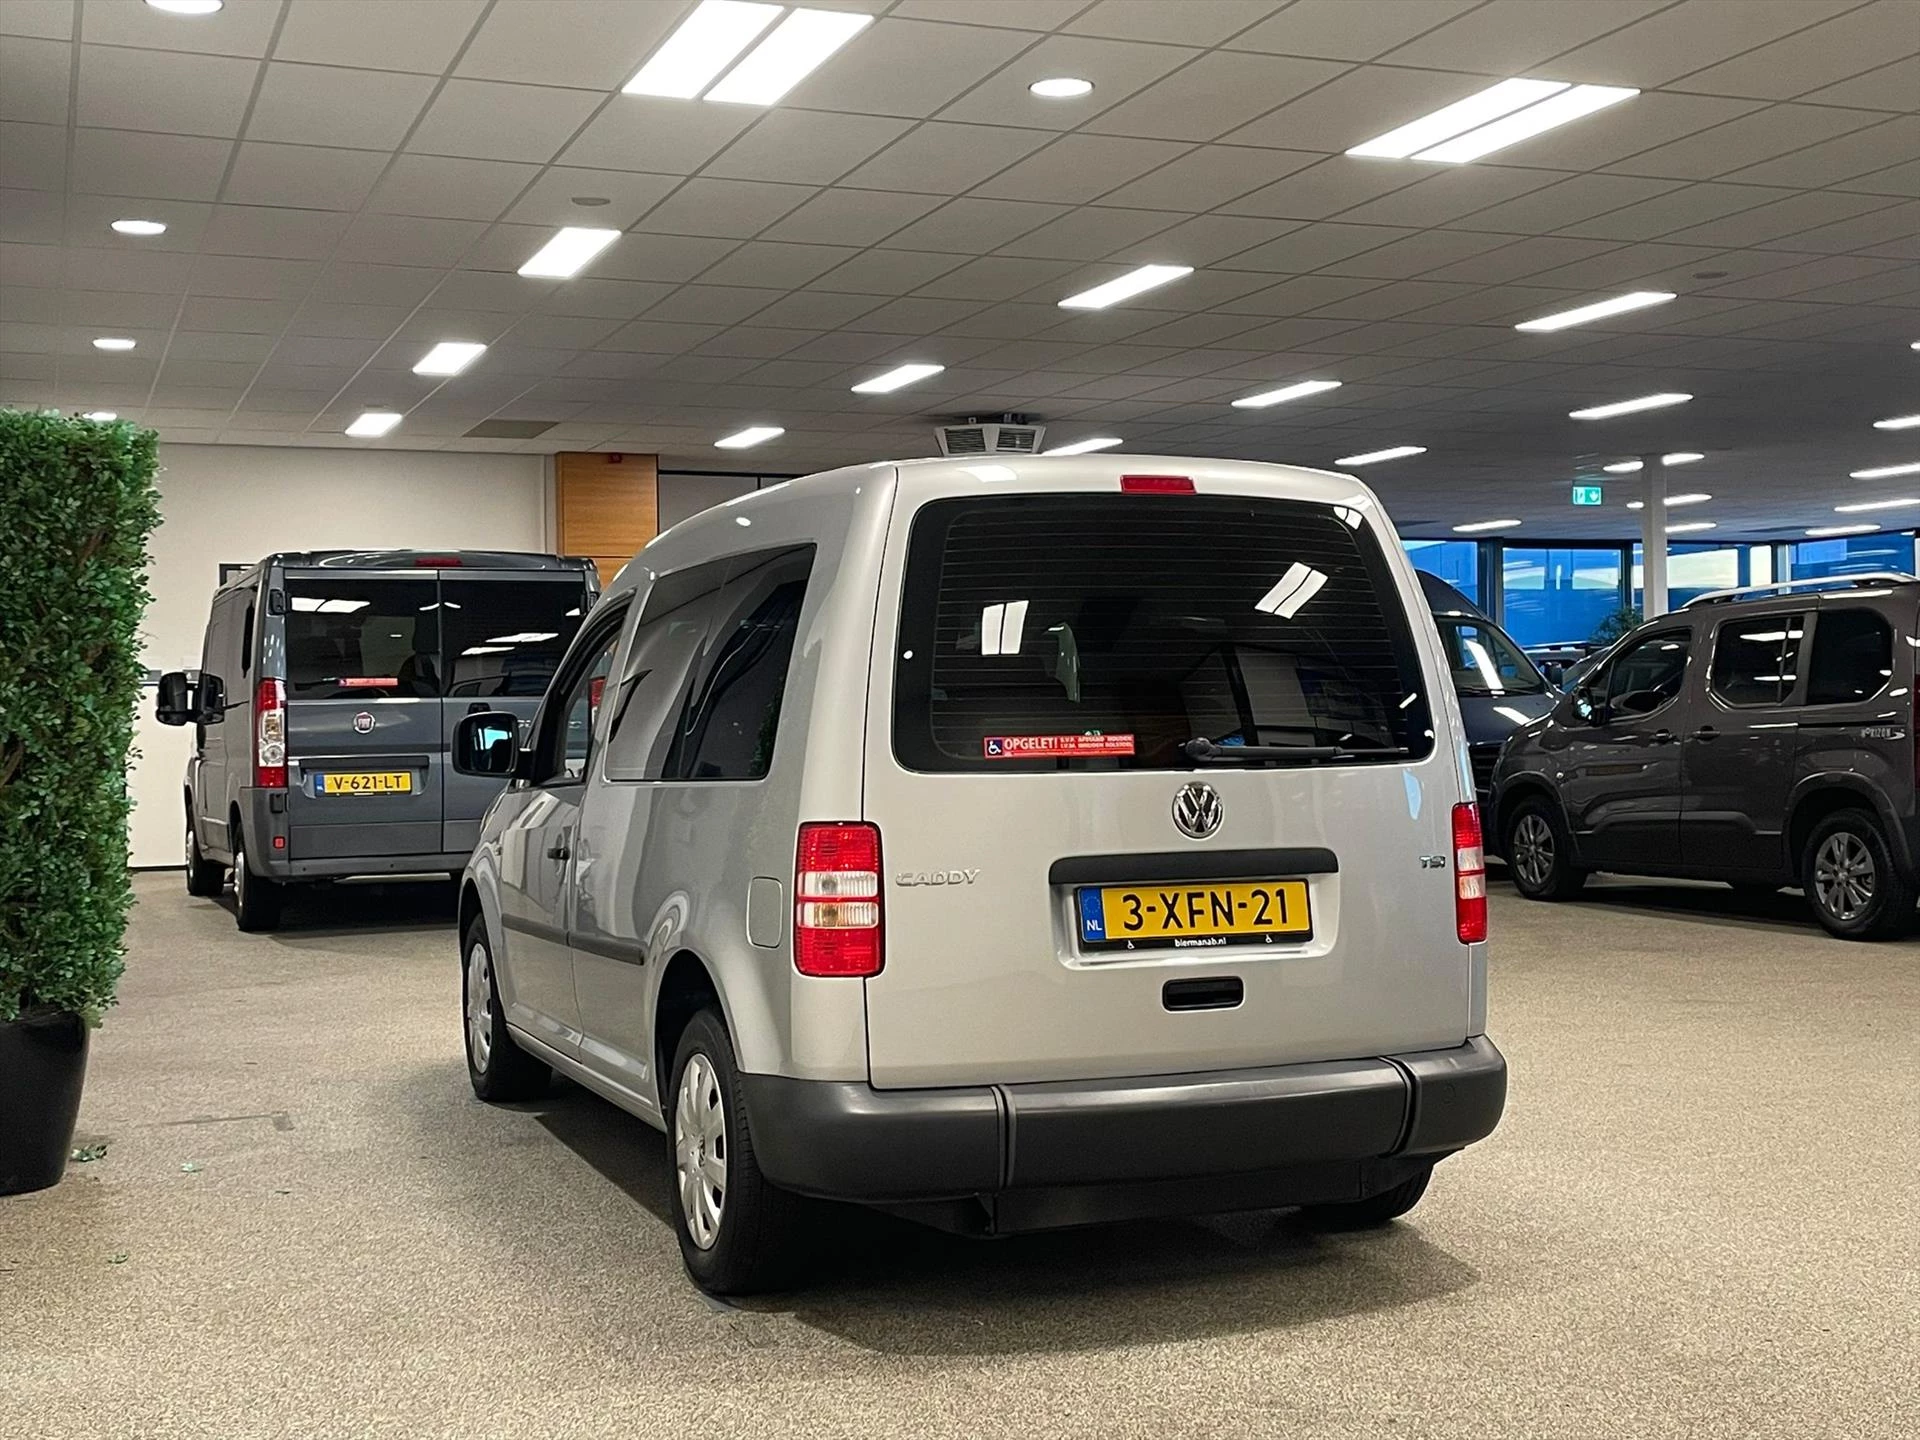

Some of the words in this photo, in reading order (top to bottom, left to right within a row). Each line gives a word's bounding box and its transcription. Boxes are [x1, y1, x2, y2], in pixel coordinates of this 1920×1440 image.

[1004, 736, 1058, 750] OPGELET!
[333, 775, 402, 790] V-621-LT
[896, 867, 981, 887] CADDY
[1122, 888, 1288, 931] 3-XFN-21
[1086, 919, 1103, 931] NL
[1174, 936, 1227, 947] biermanab.nl
